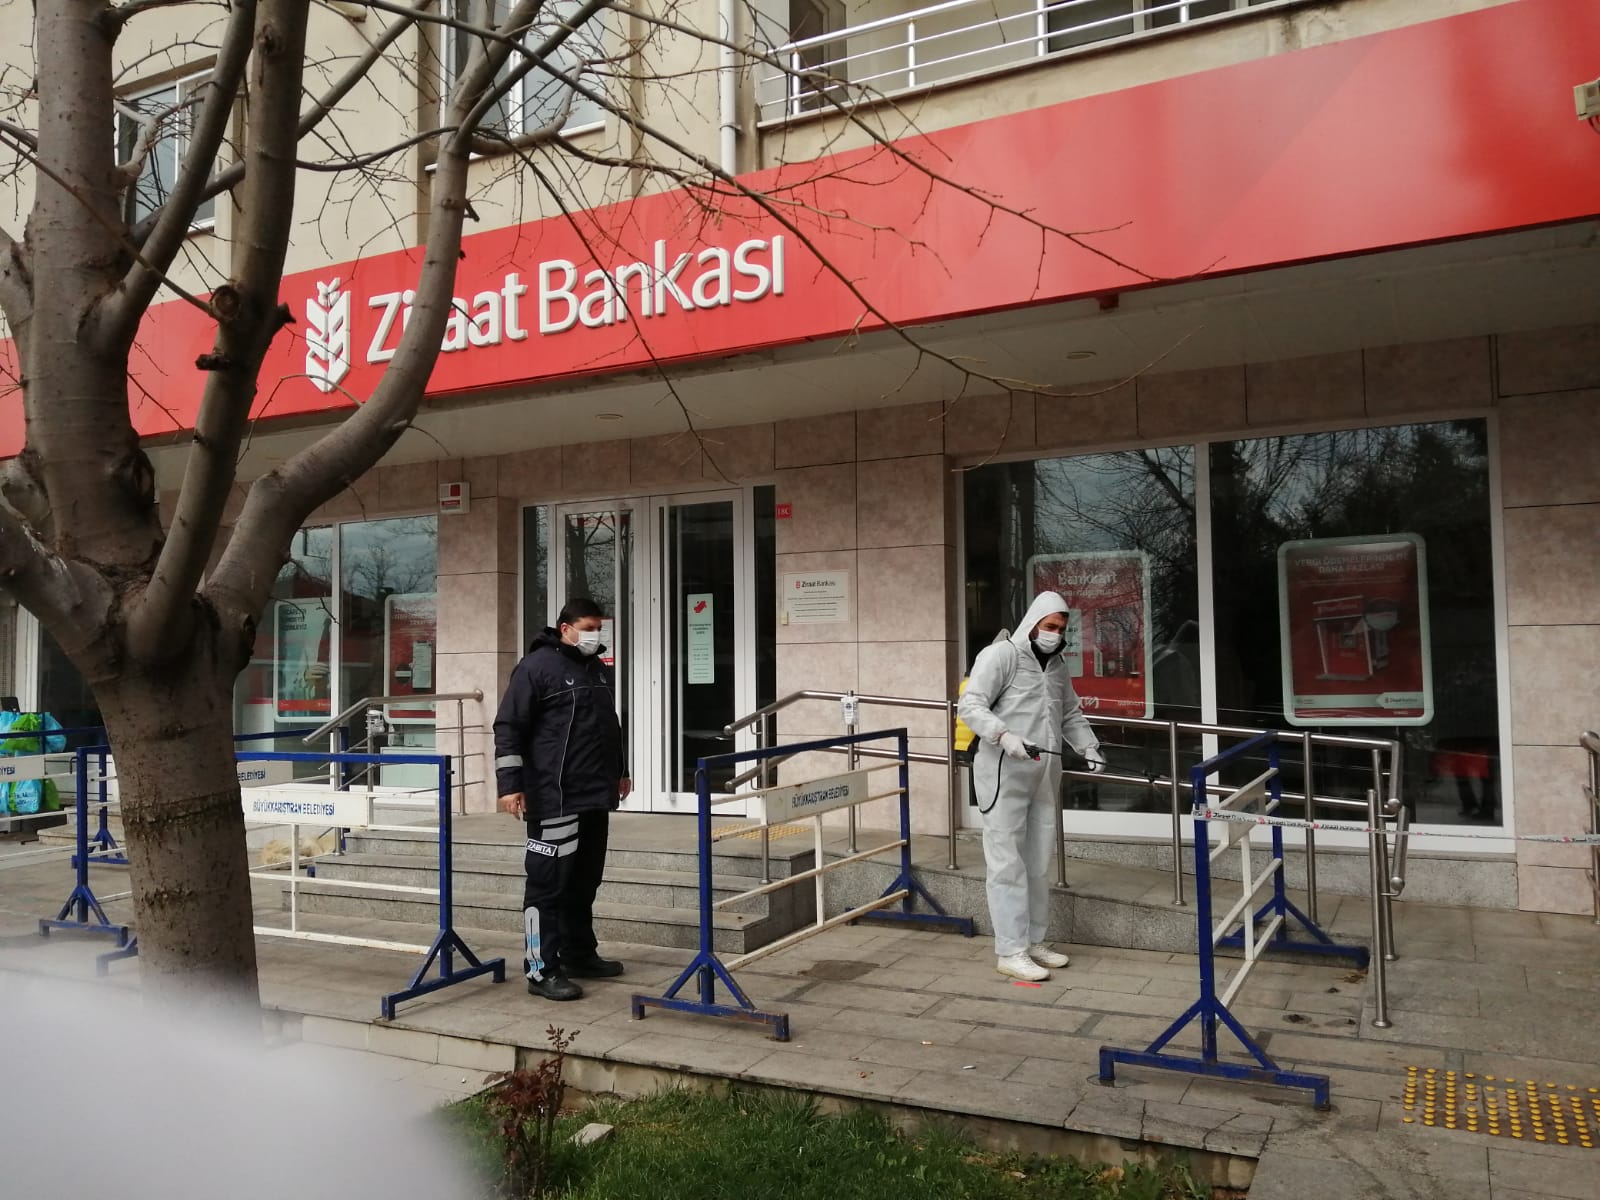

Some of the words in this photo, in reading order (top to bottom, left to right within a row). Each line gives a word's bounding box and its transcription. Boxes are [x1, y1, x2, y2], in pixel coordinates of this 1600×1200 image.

[366, 272, 528, 364] Ziaat
[539, 235, 785, 336] Bankası
[303, 803, 335, 816] BELEDİYESİ
[527, 841, 552, 854] ZABITA
